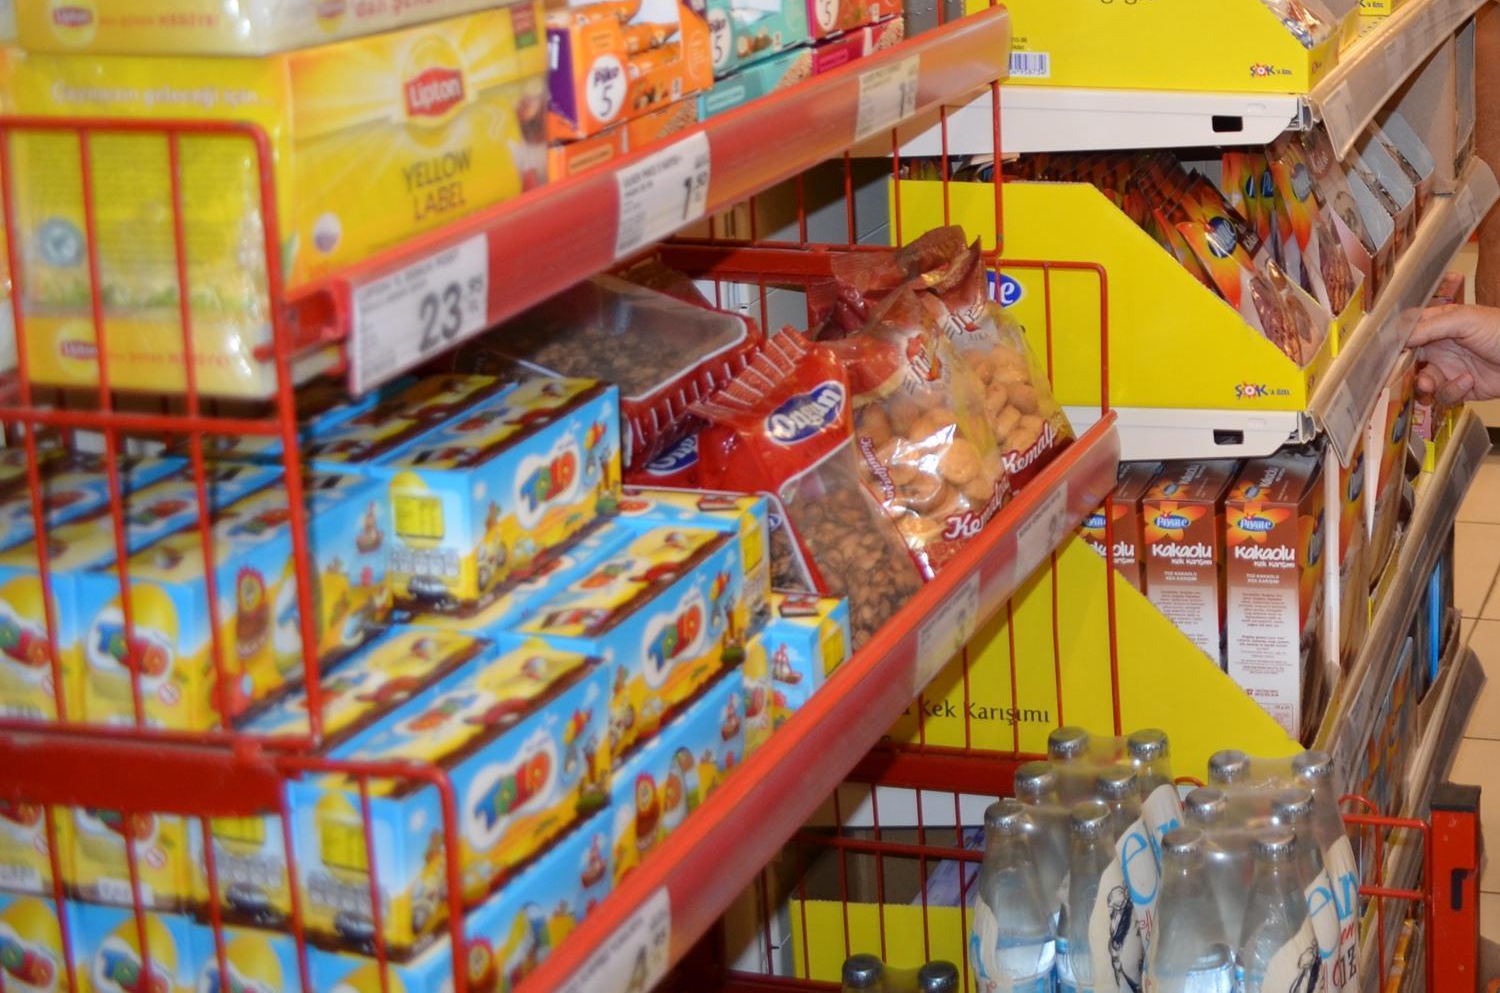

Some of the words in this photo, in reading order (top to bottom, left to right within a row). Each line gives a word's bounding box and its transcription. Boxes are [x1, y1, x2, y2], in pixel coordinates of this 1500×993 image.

[409, 77, 461, 110] Lipton
[601, 84, 613, 117] 5
[403, 146, 472, 192] YELLOW
[413, 181, 466, 221] LABEL
[419, 281, 463, 352] 23
[1152, 542, 1212, 558] Kakaolu
[1234, 544, 1295, 561] Kakaolu
